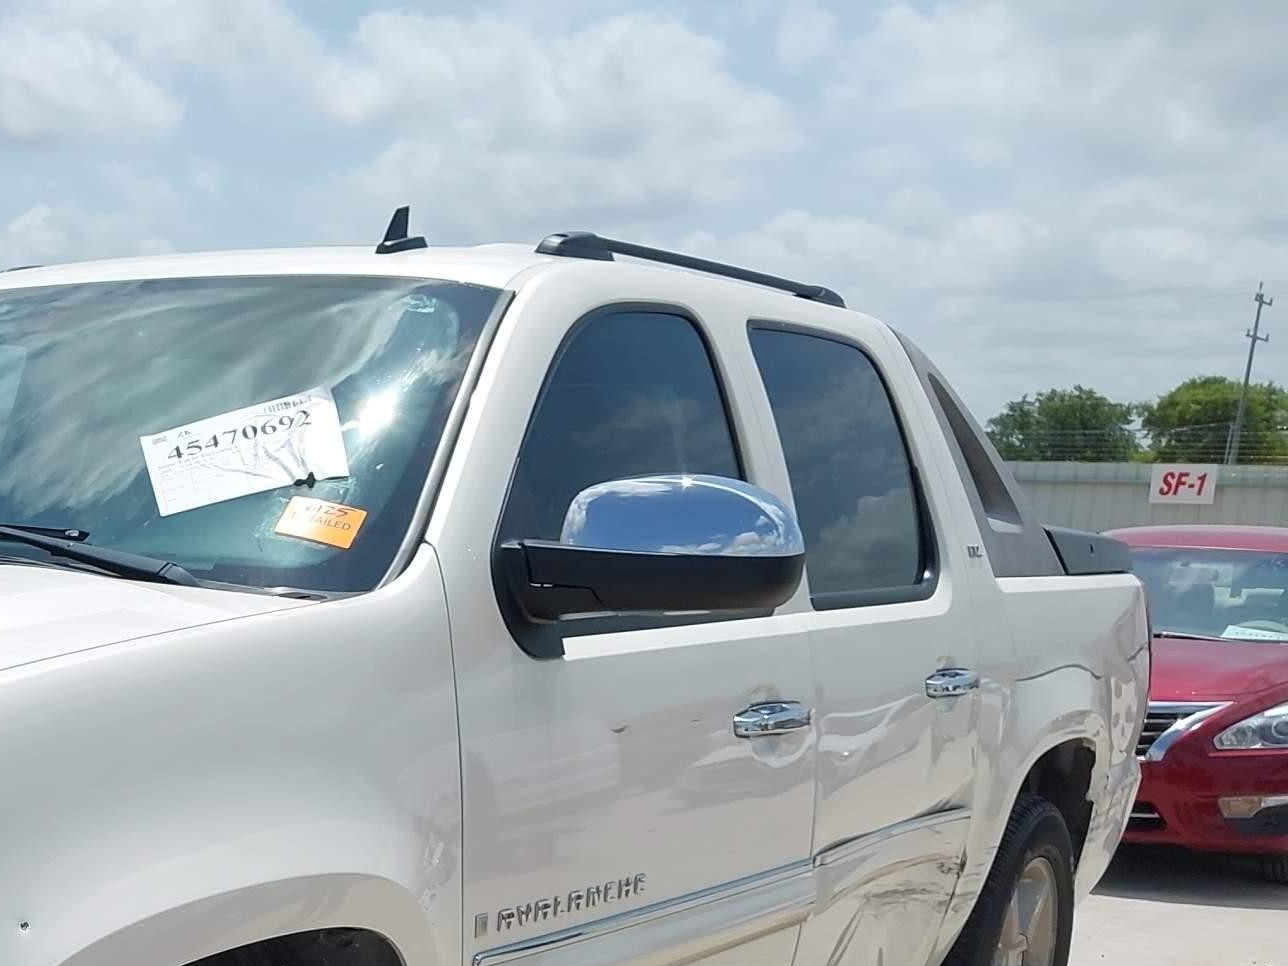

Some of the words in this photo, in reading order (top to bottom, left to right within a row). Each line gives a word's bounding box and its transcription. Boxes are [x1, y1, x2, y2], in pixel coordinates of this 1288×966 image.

[167, 410, 312, 460] 45470692
[1158, 471, 1208, 496] SF-1
[496, 872, 647, 932] AVALANCHE
